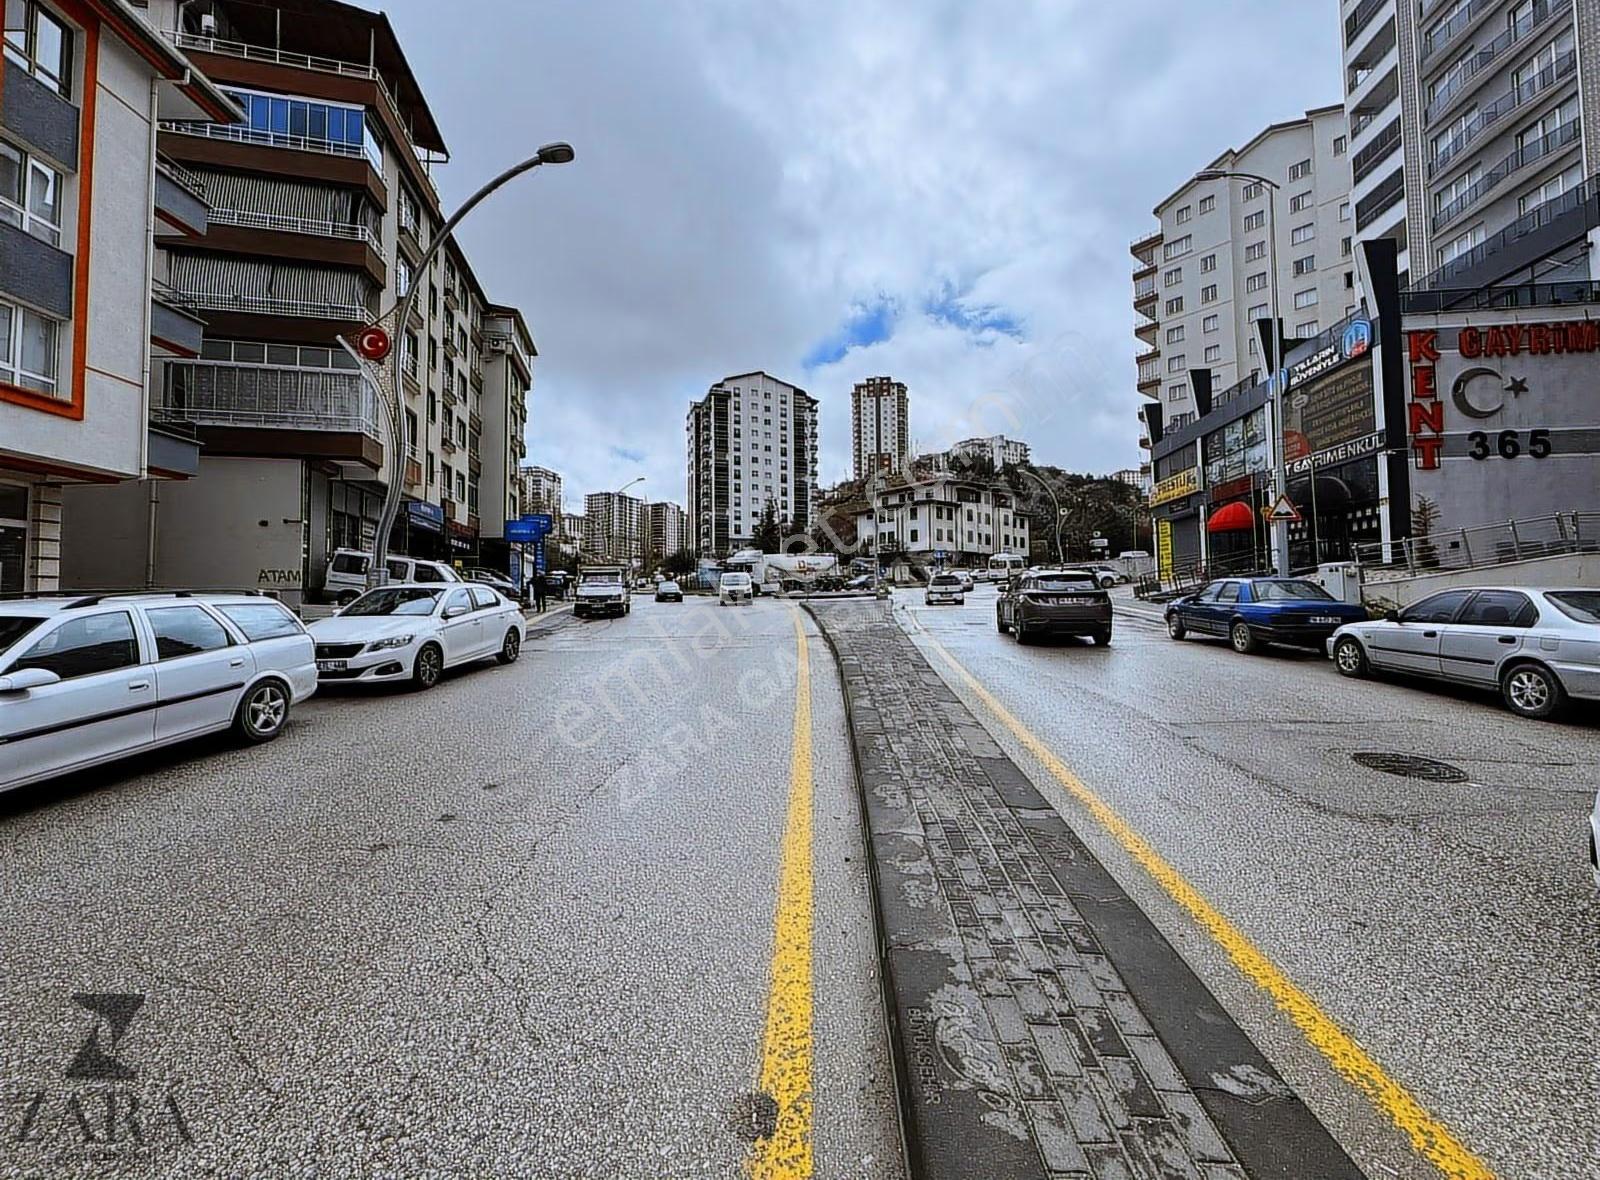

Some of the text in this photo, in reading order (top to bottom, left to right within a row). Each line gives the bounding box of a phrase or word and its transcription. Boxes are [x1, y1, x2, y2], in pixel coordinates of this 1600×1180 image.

[1408, 330, 1445, 470] KENT
[1467, 429, 1552, 461] 365
[258, 569, 302, 583] ATAM
